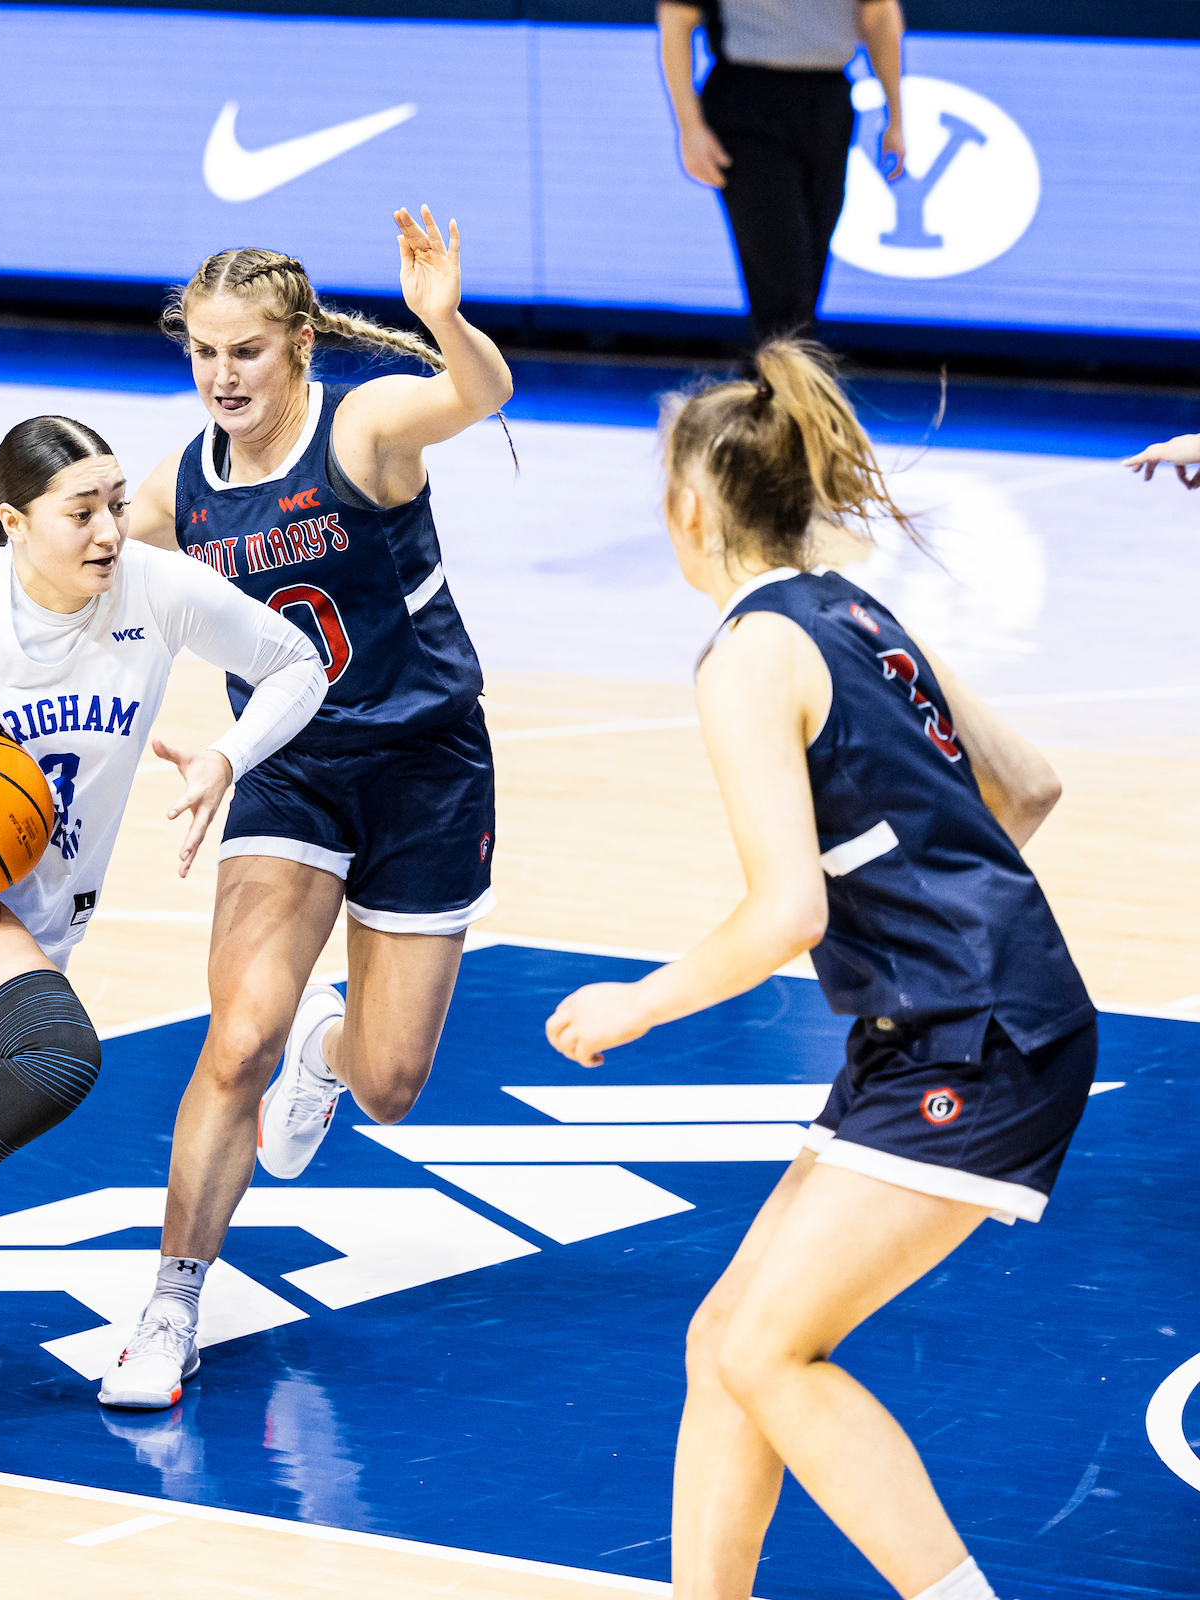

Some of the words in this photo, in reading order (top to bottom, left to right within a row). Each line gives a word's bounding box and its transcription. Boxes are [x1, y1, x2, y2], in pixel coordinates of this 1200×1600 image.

[851, 109, 988, 250] Y
[278, 487, 321, 514] WCC
[244, 512, 350, 576] MARY'S
[111, 626, 146, 643] WCC
[38, 752, 81, 827] 3
[84, 896, 91, 908] L
